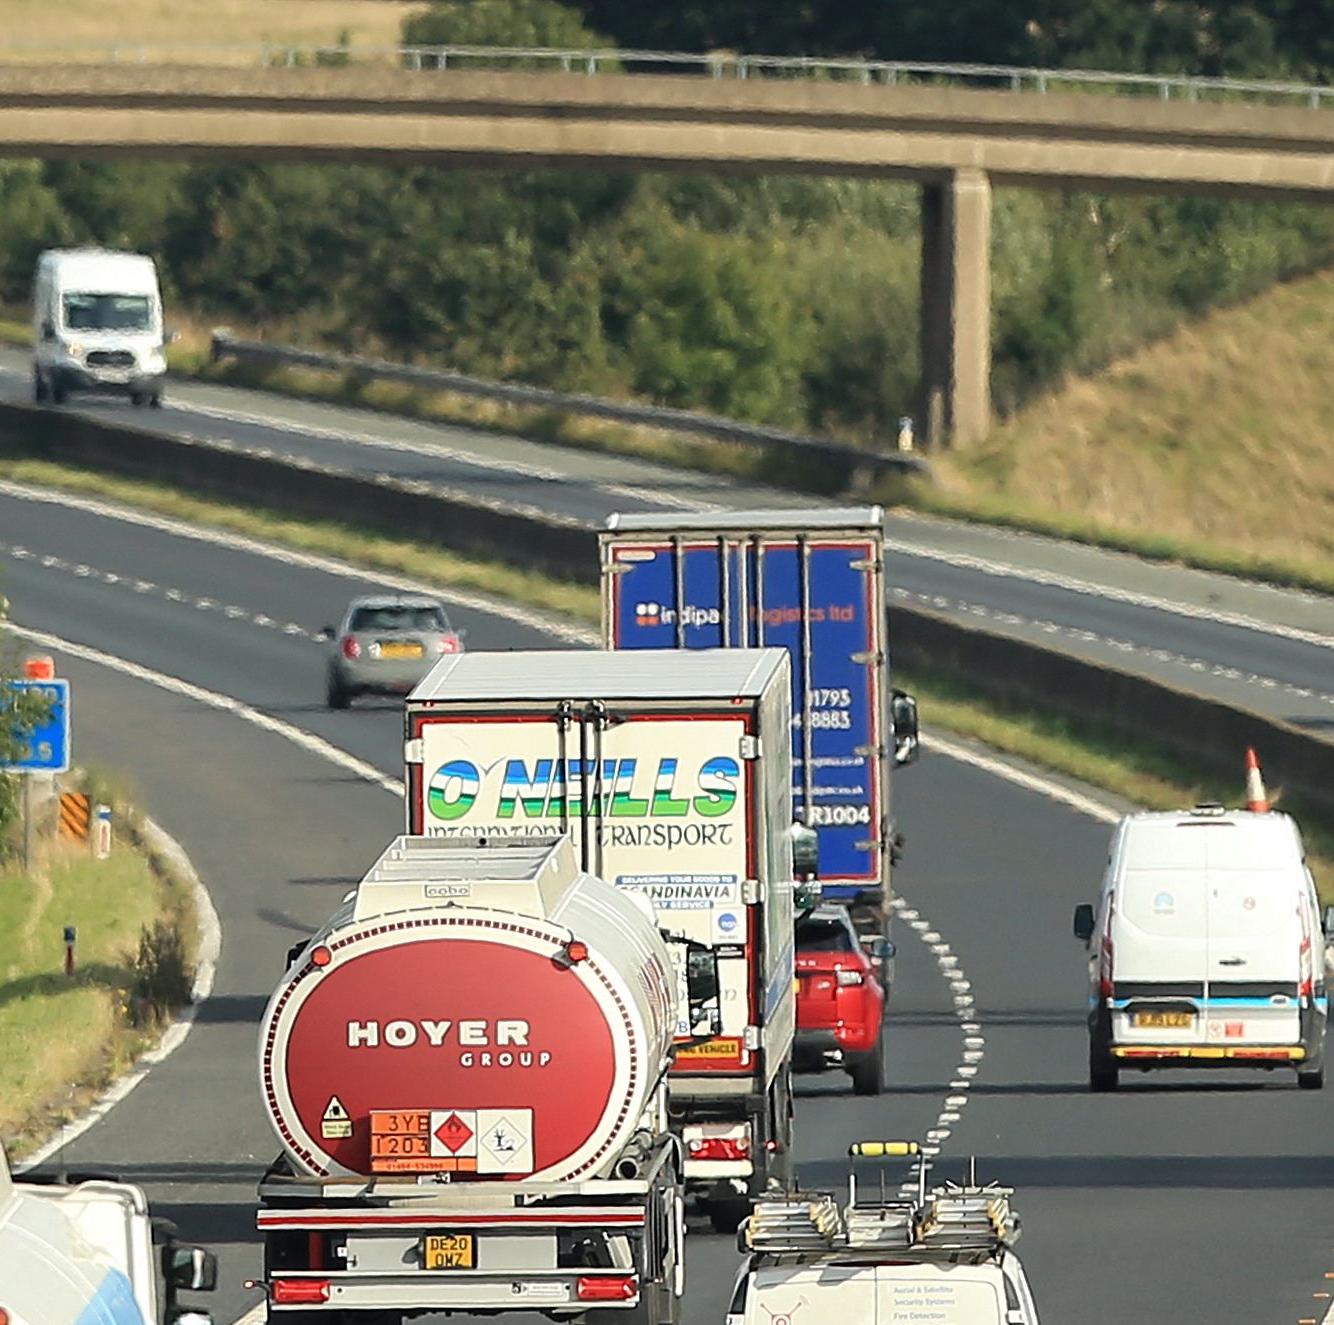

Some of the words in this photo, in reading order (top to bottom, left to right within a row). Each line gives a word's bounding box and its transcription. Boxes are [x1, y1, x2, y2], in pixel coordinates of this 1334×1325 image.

[347, 1020, 531, 1048] HOYER
[460, 1051, 552, 1067] GROUP
[375, 1137, 429, 1155] 1203
[430, 1237, 468, 1251] DE20
